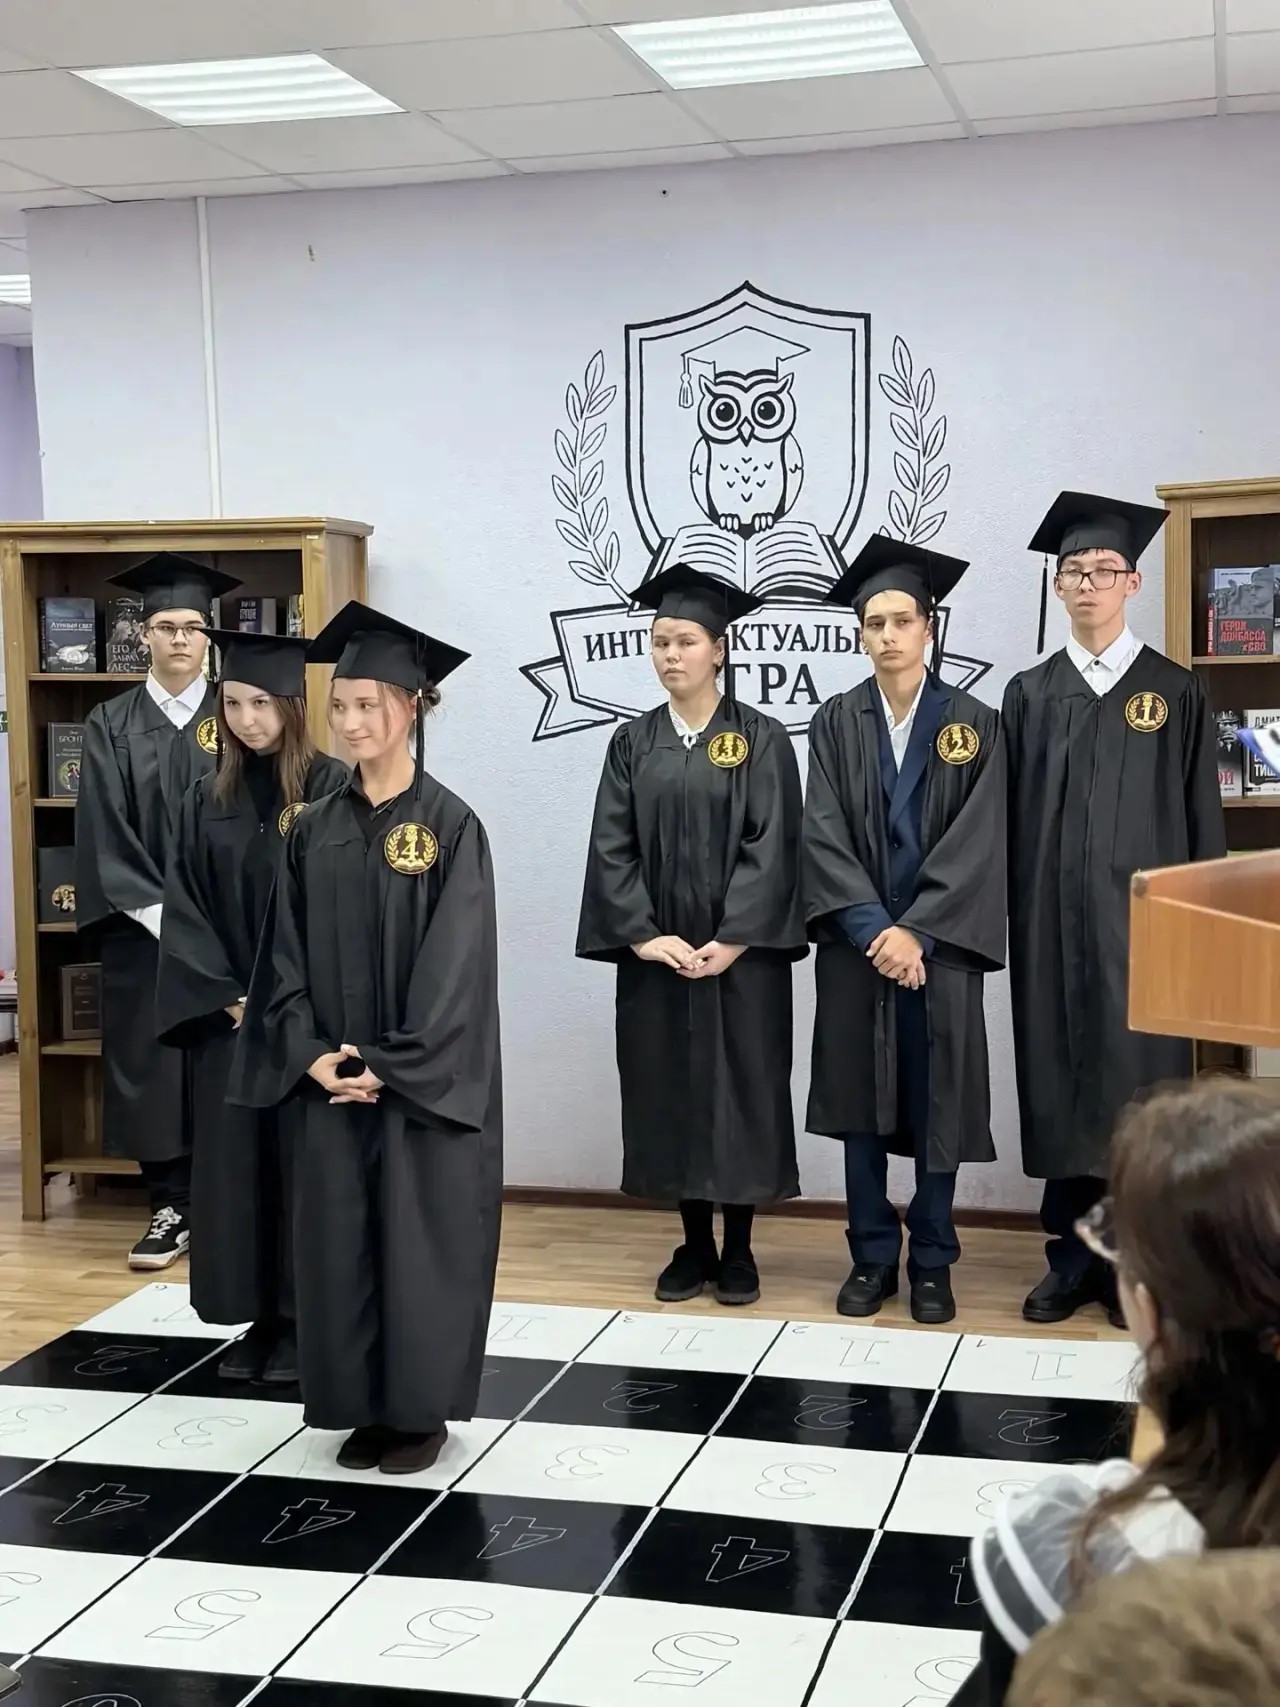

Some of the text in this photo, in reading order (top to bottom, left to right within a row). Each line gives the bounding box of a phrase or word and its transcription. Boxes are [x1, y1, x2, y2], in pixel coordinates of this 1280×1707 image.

[112, 644, 129, 653] ЕГО
[732, 664, 822, 704] ГРА
[722, 745, 733, 757] 3
[952, 739, 964, 754] 2
[400, 841, 419, 862] 4
[661, 1327, 714, 1354] 1
[839, 1336, 890, 1368] 1
[74, 1345, 160, 1376] 2
[1025, 1350, 1077, 1381] 1
[603, 1381, 678, 1414] 2
[793, 1394, 868, 1430] 2
[157, 1416, 248, 1450] 3
[998, 1409, 1067, 1445] 2
[545, 1444, 629, 1481] 3
[755, 1462, 836, 1499] 3
[53, 1483, 150, 1525] 4
[262, 1498, 356, 1544] 4
[477, 1516, 566, 1559] 4
[705, 1536, 790, 1583] 4
[145, 1589, 262, 1641] 5
[380, 1606, 494, 1660] 5
[634, 1631, 740, 1688] 5
